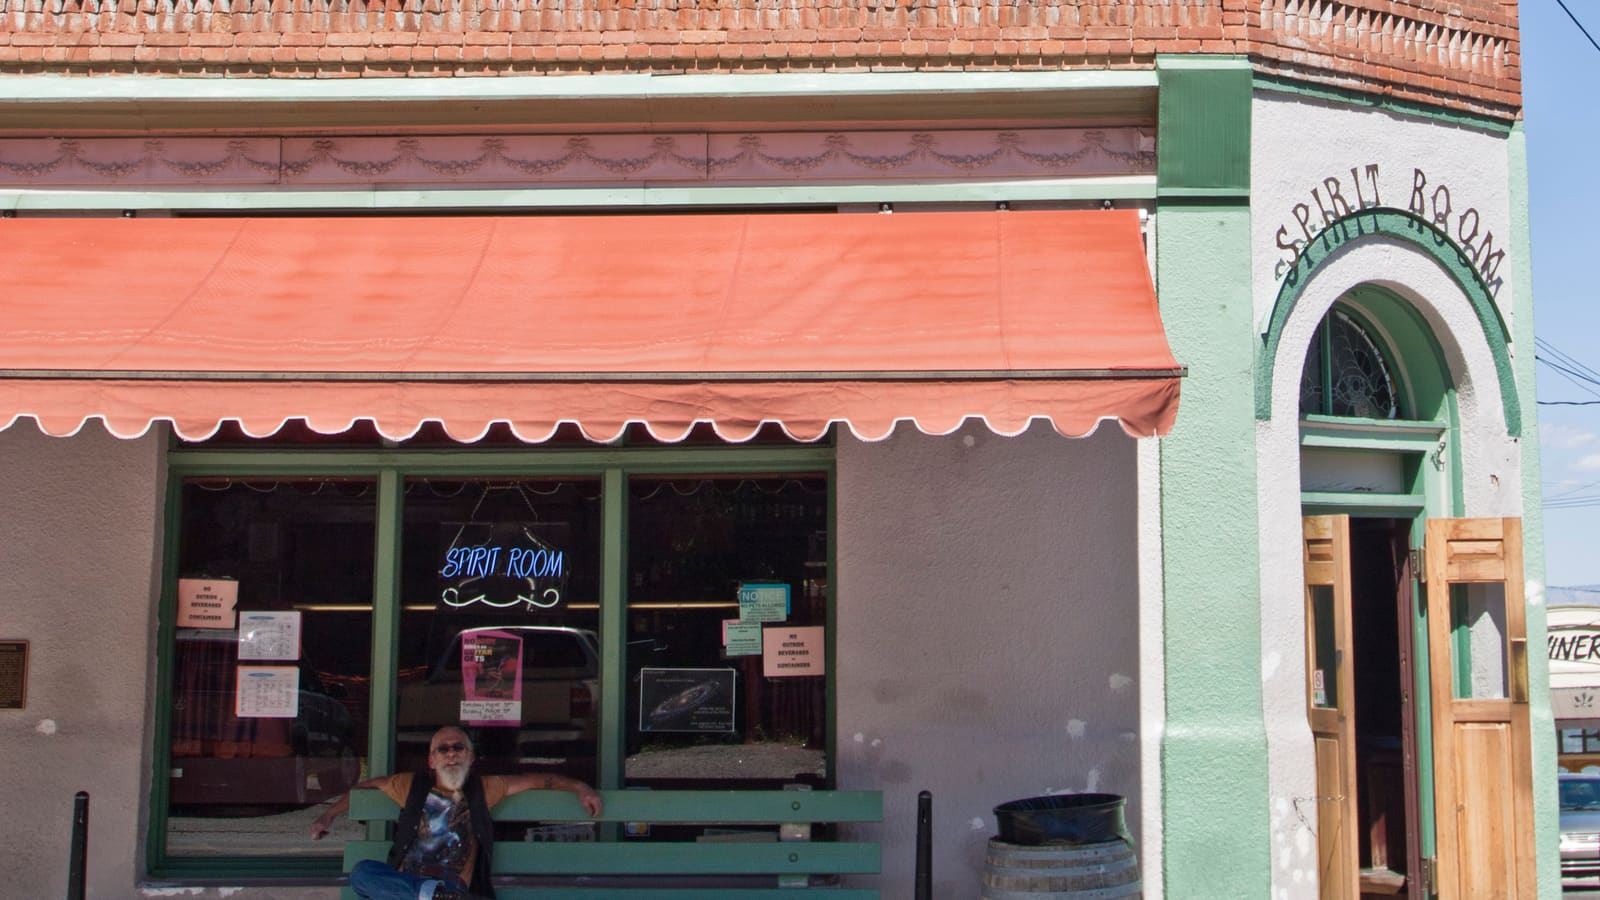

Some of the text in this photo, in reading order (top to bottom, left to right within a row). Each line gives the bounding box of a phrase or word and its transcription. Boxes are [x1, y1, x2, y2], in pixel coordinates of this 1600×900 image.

[1276, 164, 1506, 284] SPIRIT ROOM
[441, 547, 563, 578] SPIRIT ROOM
[741, 591, 785, 602] NOTICE
[1547, 634, 1600, 661] INER
